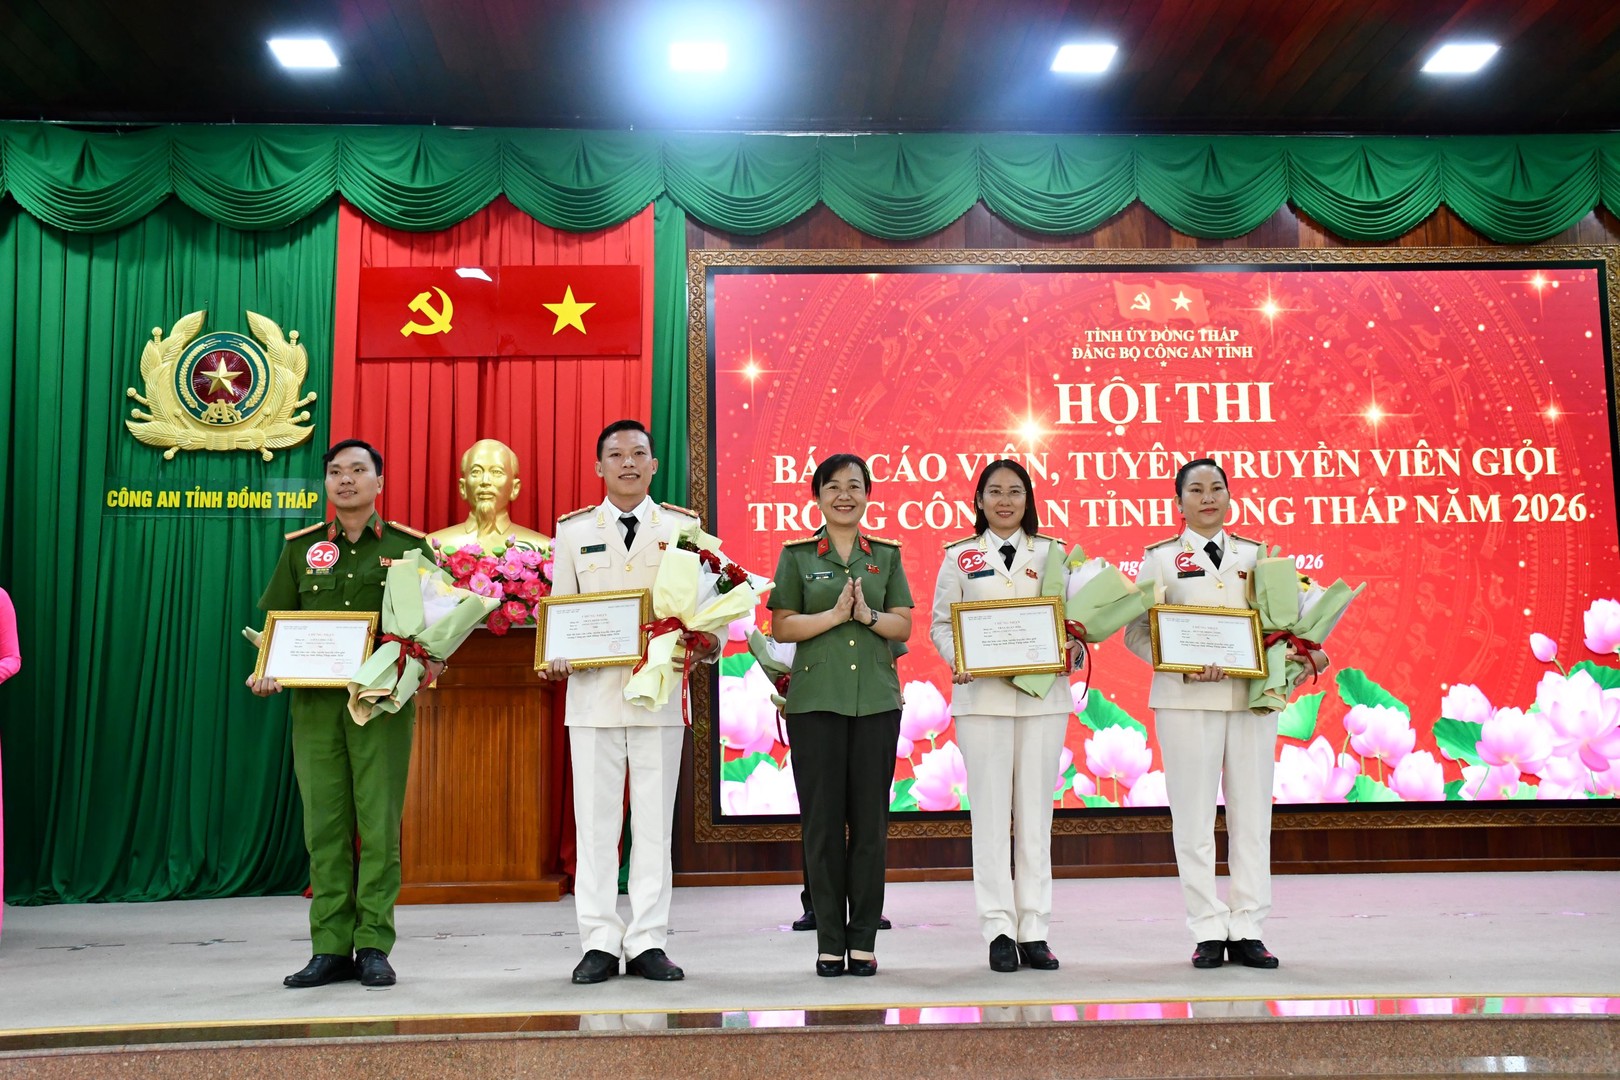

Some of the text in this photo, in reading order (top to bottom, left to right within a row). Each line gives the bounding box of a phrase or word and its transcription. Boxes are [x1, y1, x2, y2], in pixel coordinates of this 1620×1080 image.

[1085, 326, 1239, 342] TỈNH ỦY ĐỒNG THÁP
[1072, 343, 1253, 361] ĐẢNG BỘ CÔNG AN TỈNH
[1055, 376, 1277, 436] HỘI THI
[772, 446, 818, 484] BÁ
[865, 445, 947, 483] CÁO
[956, 443, 1060, 487] VN,
[1206, 441, 1360, 479] TRUYỀN
[1370, 439, 1461, 477] VIÊN
[106, 485, 319, 509] CÔNG AN TỈNH ĐỒNG THÁP
[748, 500, 887, 532] TROG
[897, 490, 977, 531] CÔN
[1037, 499, 1071, 528] N
[1079, 489, 1176, 528] TỈNH
[1304, 487, 1407, 525] THÁP
[1415, 487, 1504, 524] NĂM
[1511, 492, 1588, 523] 2026
[311, 549, 334, 563] 26
[961, 554, 982, 569] 23
[1287, 554, 1324, 570] 026
